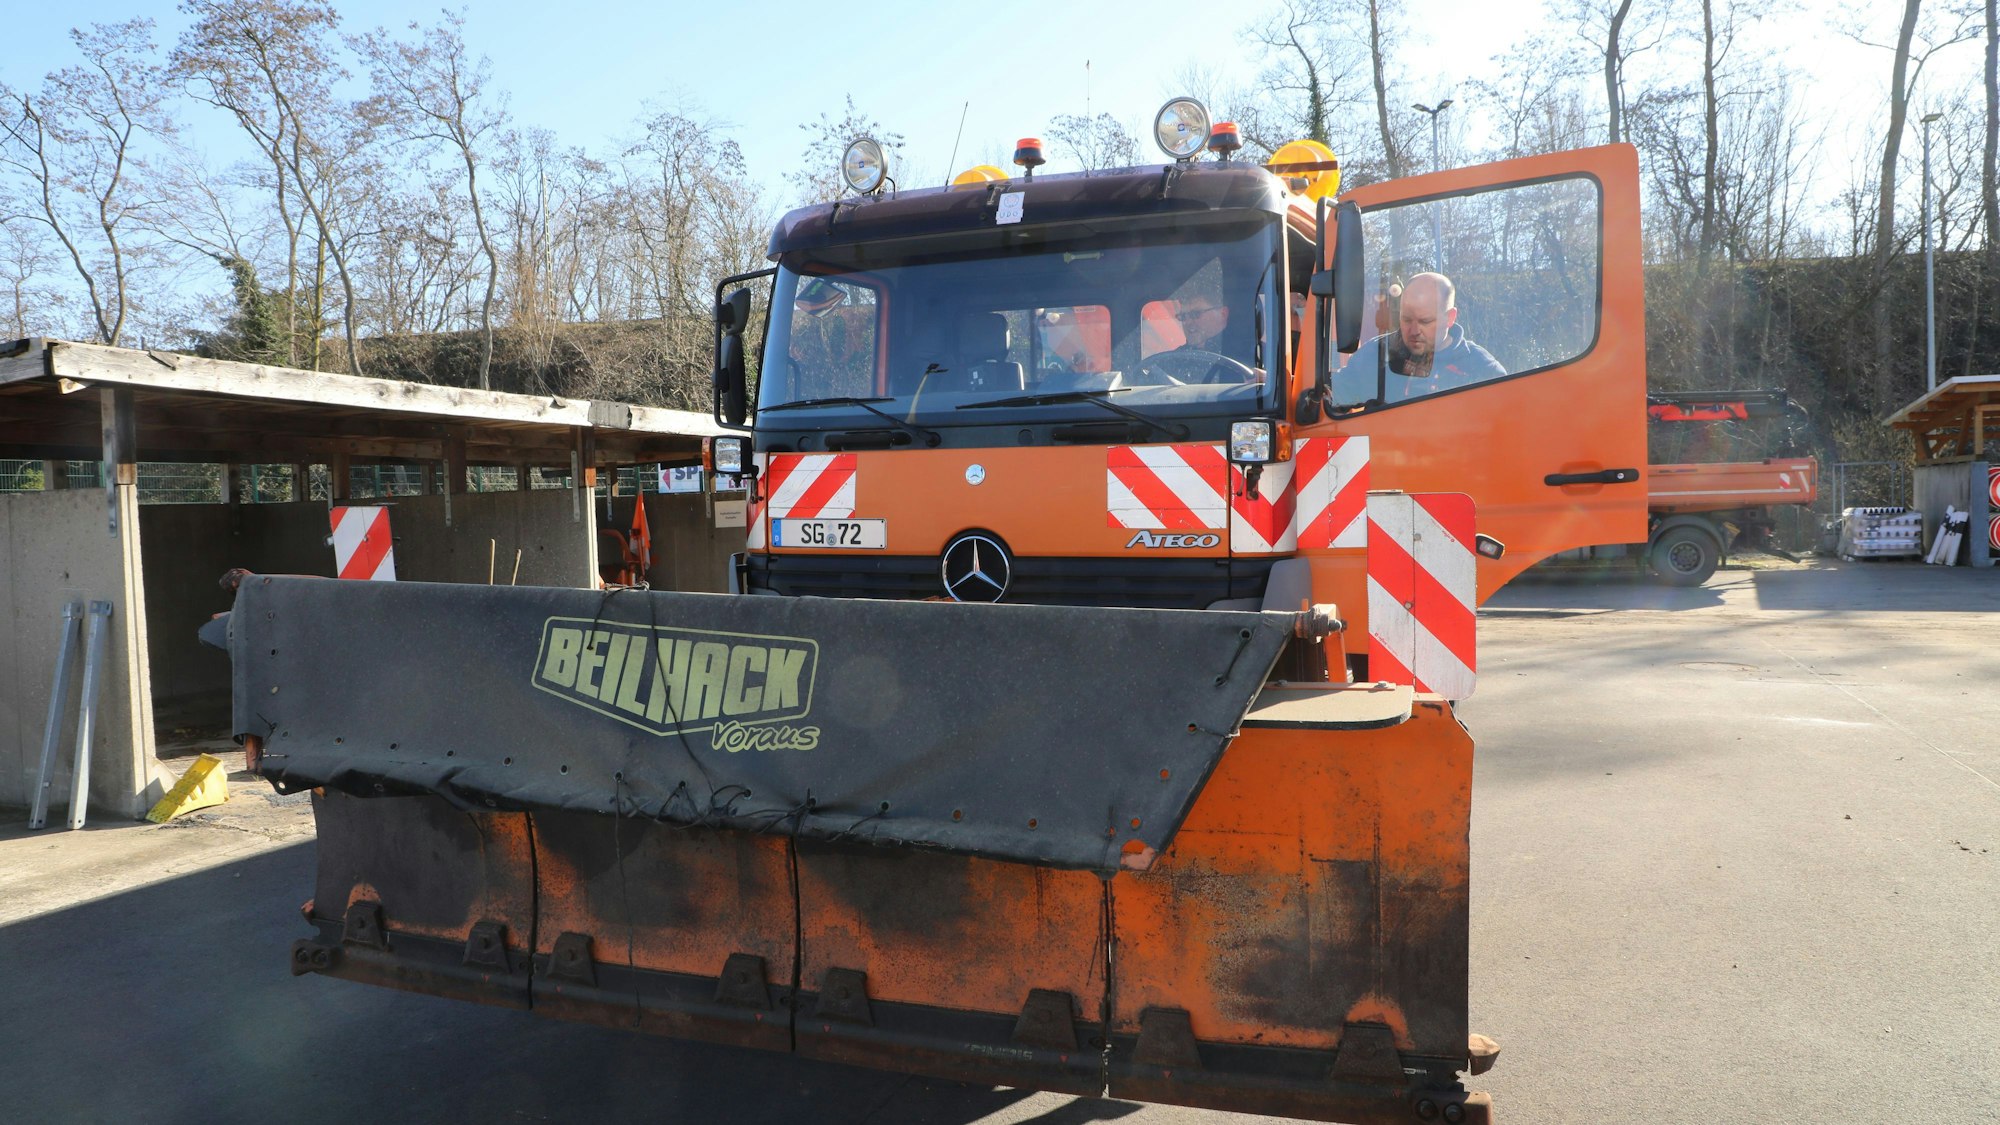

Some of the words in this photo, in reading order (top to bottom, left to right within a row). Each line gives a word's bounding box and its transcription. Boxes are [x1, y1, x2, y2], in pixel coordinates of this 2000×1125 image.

[801, 523, 824, 544] SG
[838, 523, 861, 545] 72
[1125, 529, 1220, 549] ATEGO
[542, 627, 807, 724] BEILHACK
